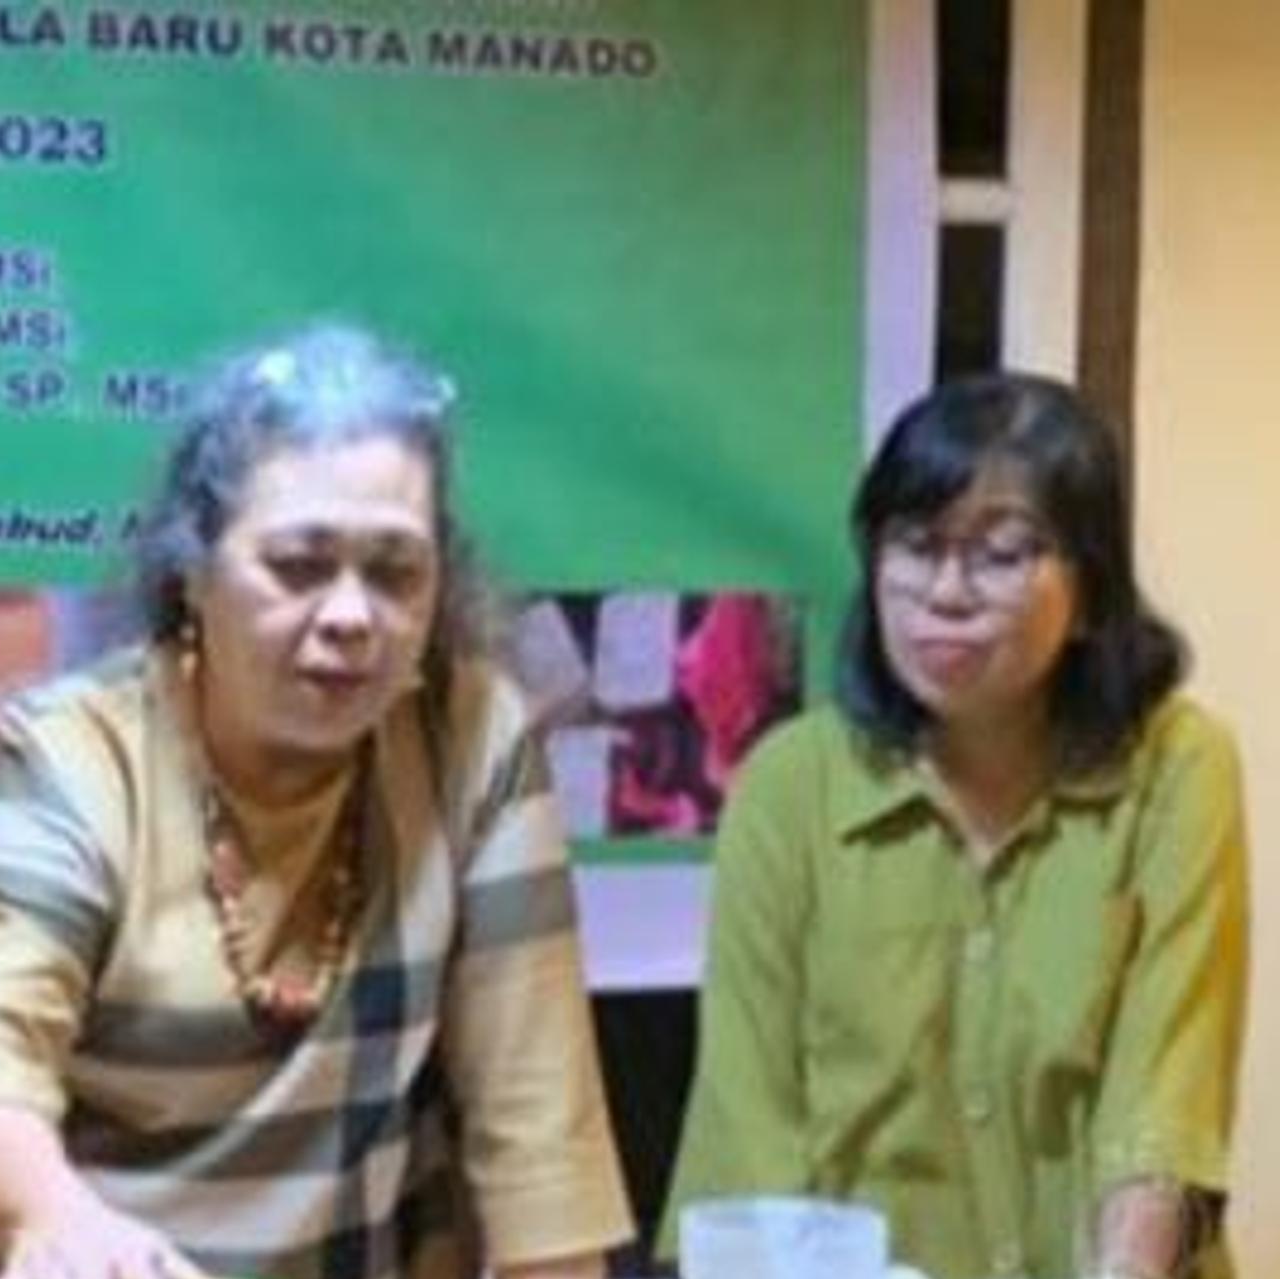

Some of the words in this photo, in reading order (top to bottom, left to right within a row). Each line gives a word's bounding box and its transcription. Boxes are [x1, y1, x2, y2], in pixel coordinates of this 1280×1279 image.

[89, 10, 243, 57] BARU
[265, 19, 408, 65] KOTA
[428, 29, 658, 77] MANADO
